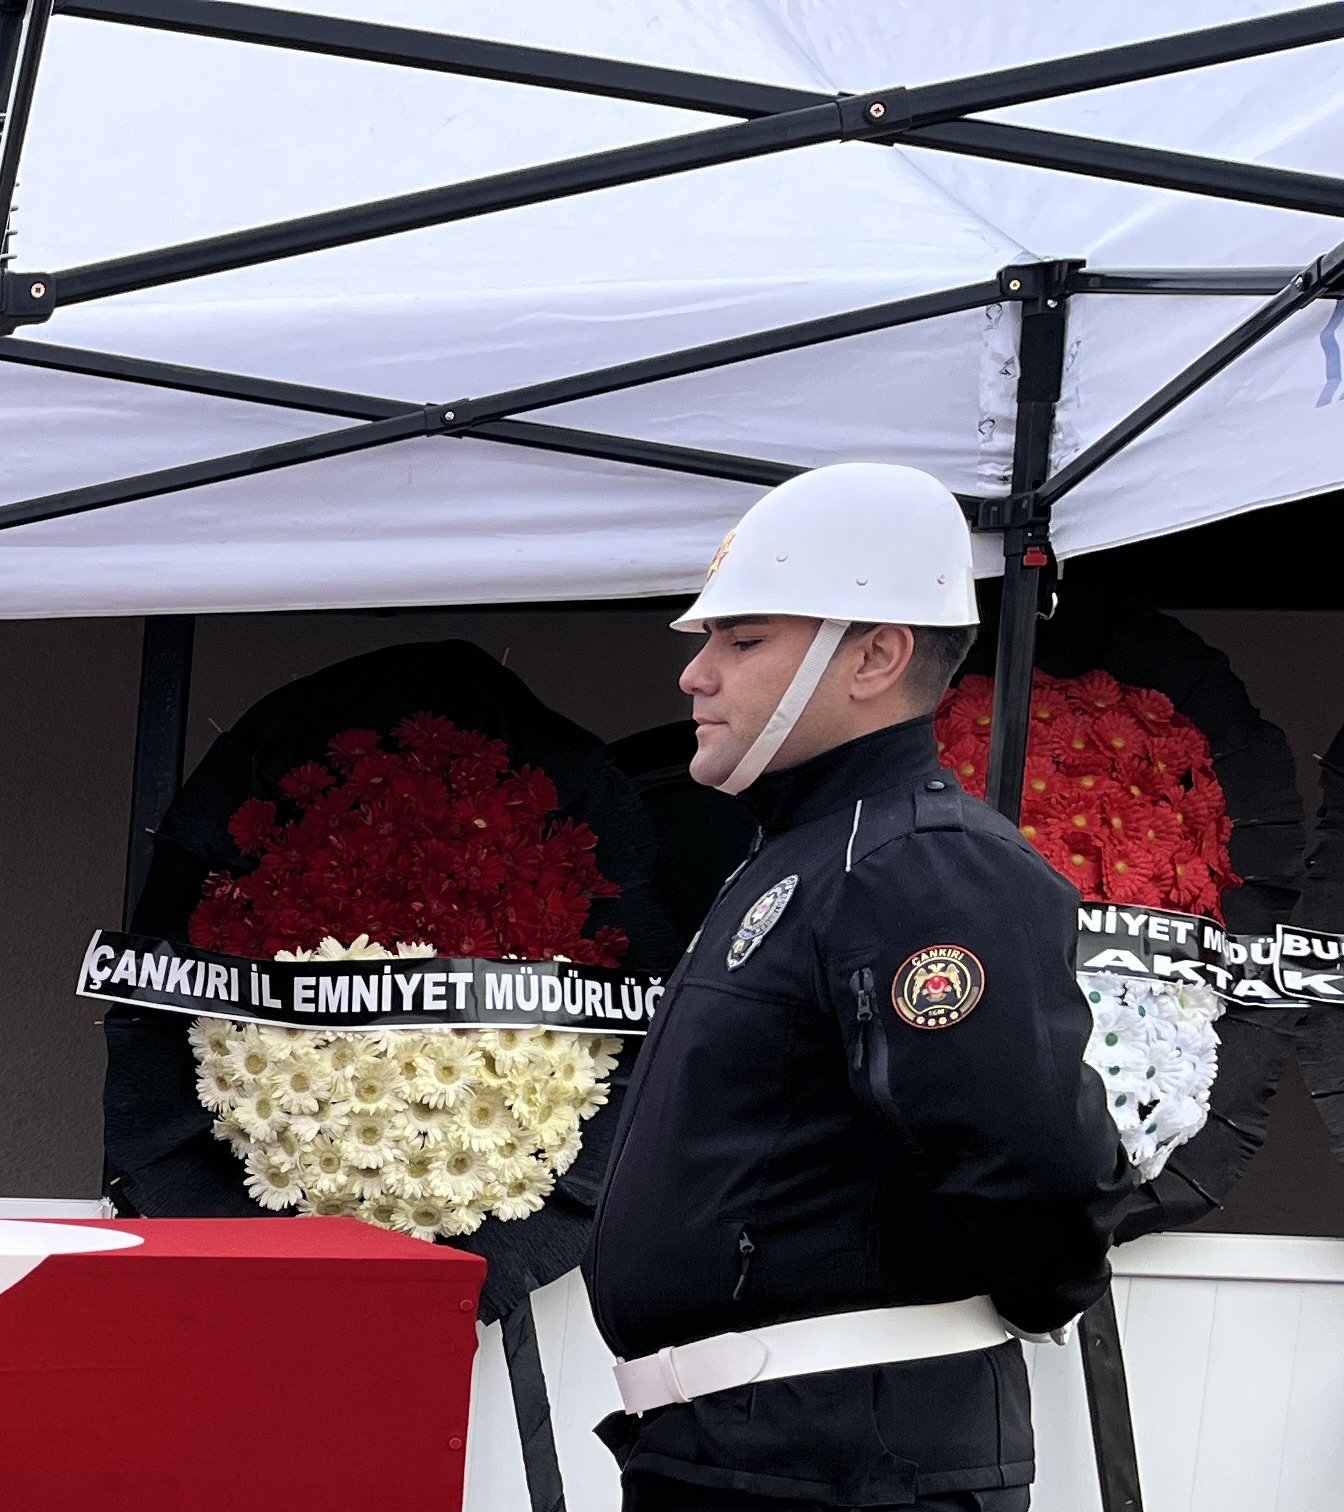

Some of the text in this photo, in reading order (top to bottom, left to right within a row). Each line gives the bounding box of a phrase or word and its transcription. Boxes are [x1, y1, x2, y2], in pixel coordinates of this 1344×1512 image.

[1078, 905, 1194, 944] NİYET
[911, 948, 964, 967] ÇANKIRI
[1282, 933, 1344, 961] BU
[88, 944, 239, 1002] ÇANKIRI
[250, 963, 282, 1009] İL
[293, 965, 473, 1013] EMNİYET
